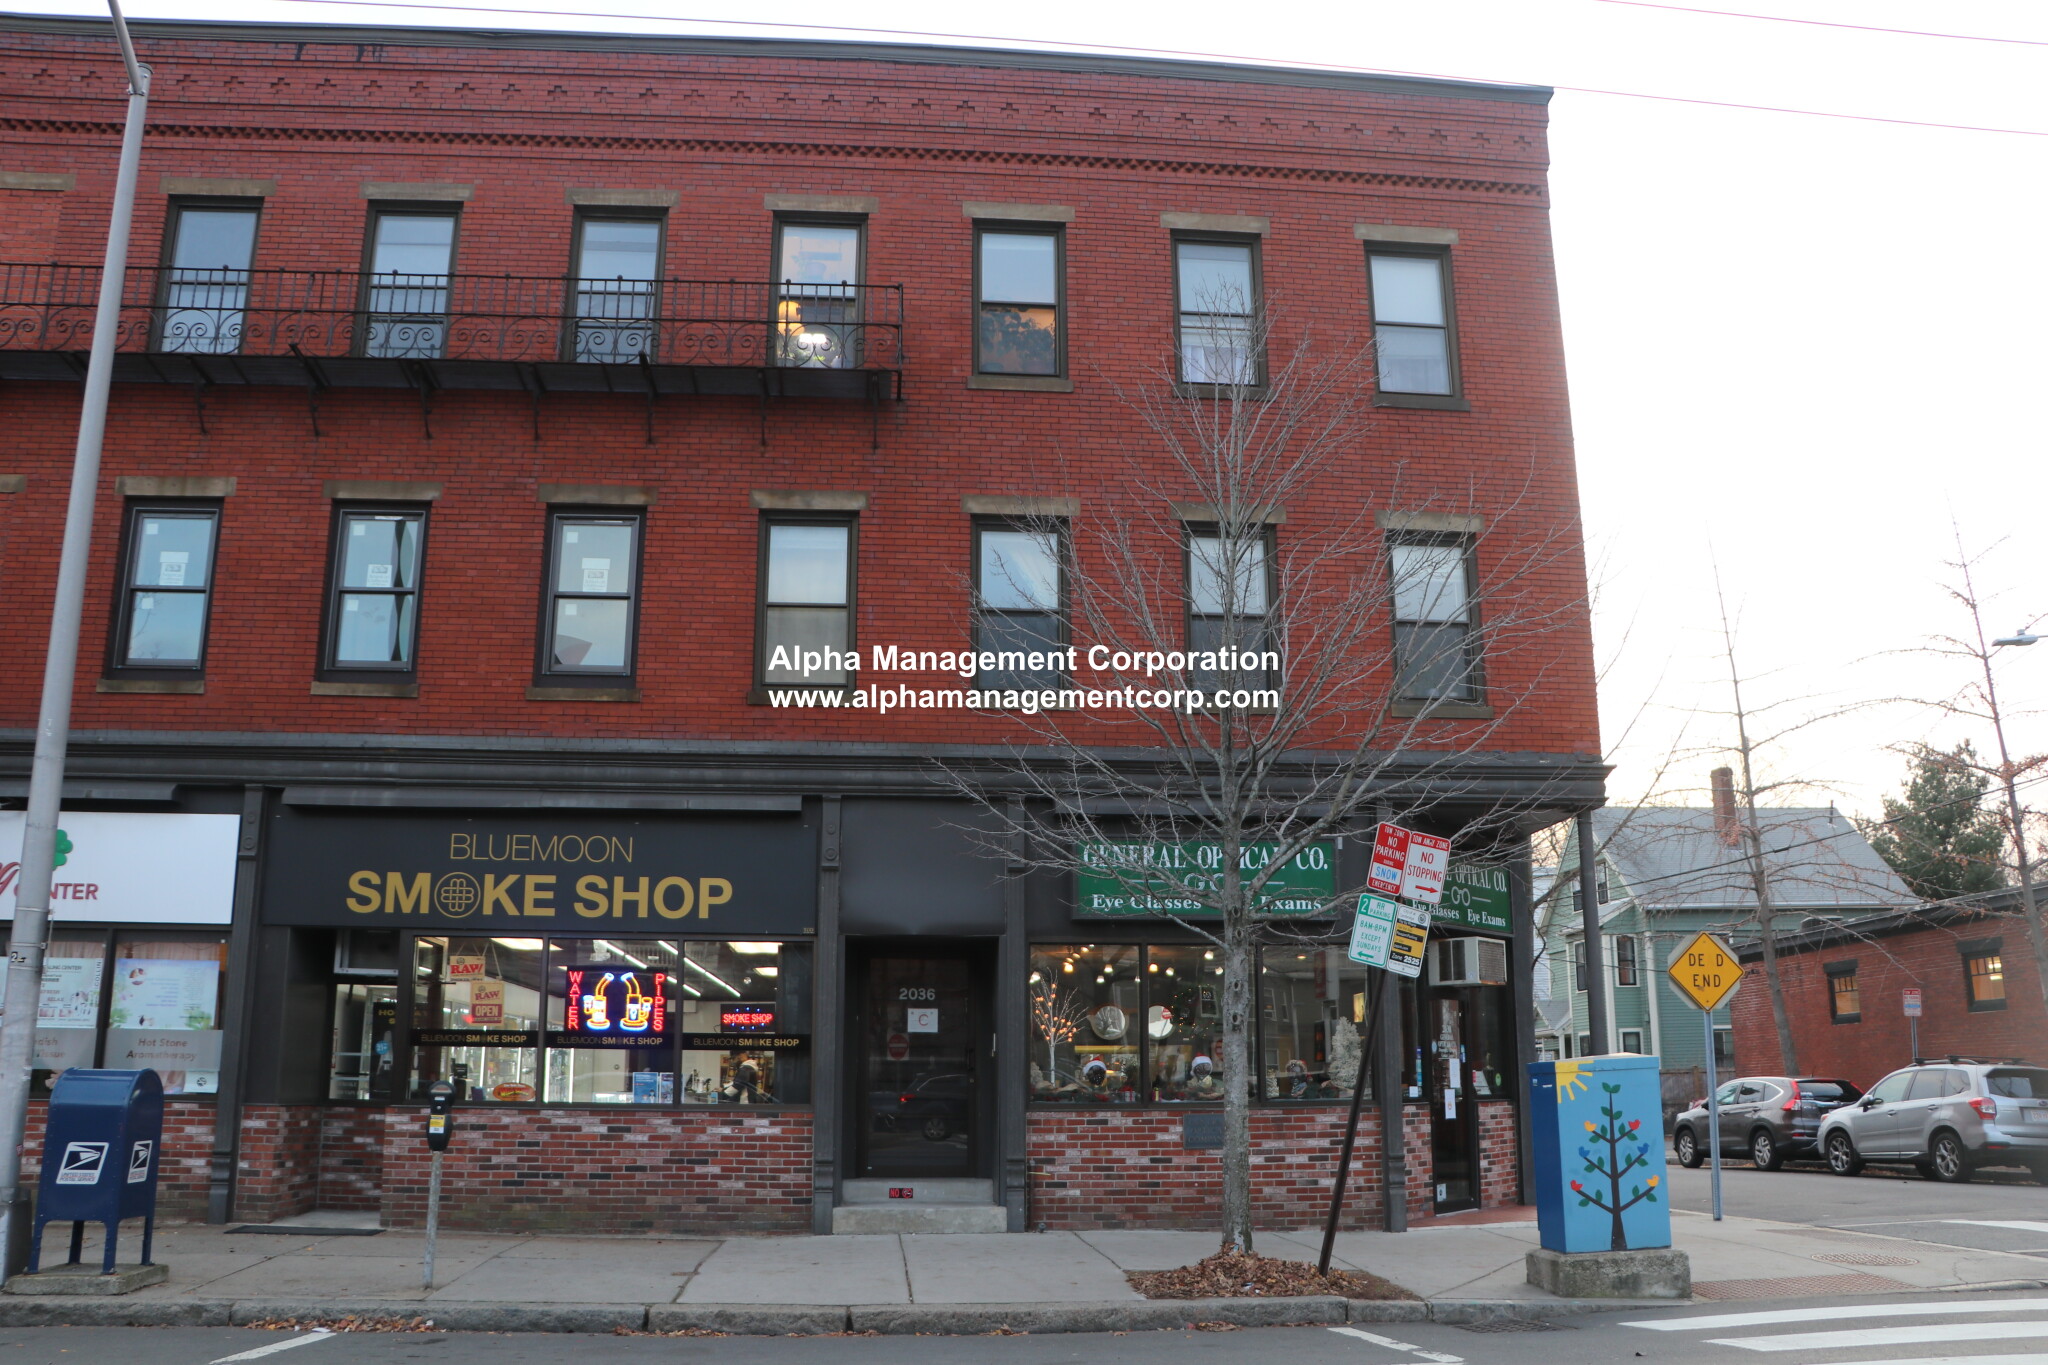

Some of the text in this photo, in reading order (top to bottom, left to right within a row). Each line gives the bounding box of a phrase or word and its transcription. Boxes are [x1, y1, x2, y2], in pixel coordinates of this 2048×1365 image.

[449, 833, 634, 863] BLUEMOON
[1387, 836, 1398, 848] NO
[1412, 835, 1422, 844] TOW
[1436, 840, 1449, 850] ZONE
[1083, 843, 1186, 869] GENERAL
[1296, 846, 1329, 870] CO.
[1375, 845, 1406, 862] PARKING
[1420, 851, 1435, 865] NO
[1375, 866, 1398, 881] SNOW
[1407, 864, 1443, 883] STOPPING
[1455, 862, 1491, 889] OPTICAL
[1493, 870, 1507, 893] CO.
[1371, 879, 1397, 893] EMERGENCY
[573, 874, 734, 919] SHOP
[1092, 893, 1124, 912] Eye
[1129, 893, 1202, 911] Glasses
[1260, 895, 1322, 911] Exams
[1360, 898, 1369, 913] 2
[1467, 908, 1481, 925] Eye
[1482, 911, 1506, 927] Exams
[1361, 932, 1382, 943] EXCEPT
[1356, 940, 1382, 953] SUNDAYS
[1403, 955, 1420, 966] 2525
[450, 963, 483, 975] RAW
[1693, 974, 1721, 987] END
[475, 990, 500, 1001] RAW
[568, 971, 583, 1030] WATER
[899, 988, 936, 1000] 2036
[653, 973, 665, 1031] PIPES
[475, 1005, 499, 1017] OPEN
[723, 1013, 773, 1024] SMOKE SHOP
[918, 1014, 929, 1027] C
[138, 1038, 188, 1047] Hot Stone
[501, 1034, 527, 1043] SHOP
[637, 1037, 663, 1045] SHOP
[693, 1038, 737, 1046] BLUEMOON
[774, 1039, 799, 1047] SHOP
[126, 1050, 197, 1061] Aromatherapy
[890, 1188, 900, 1198] NO
